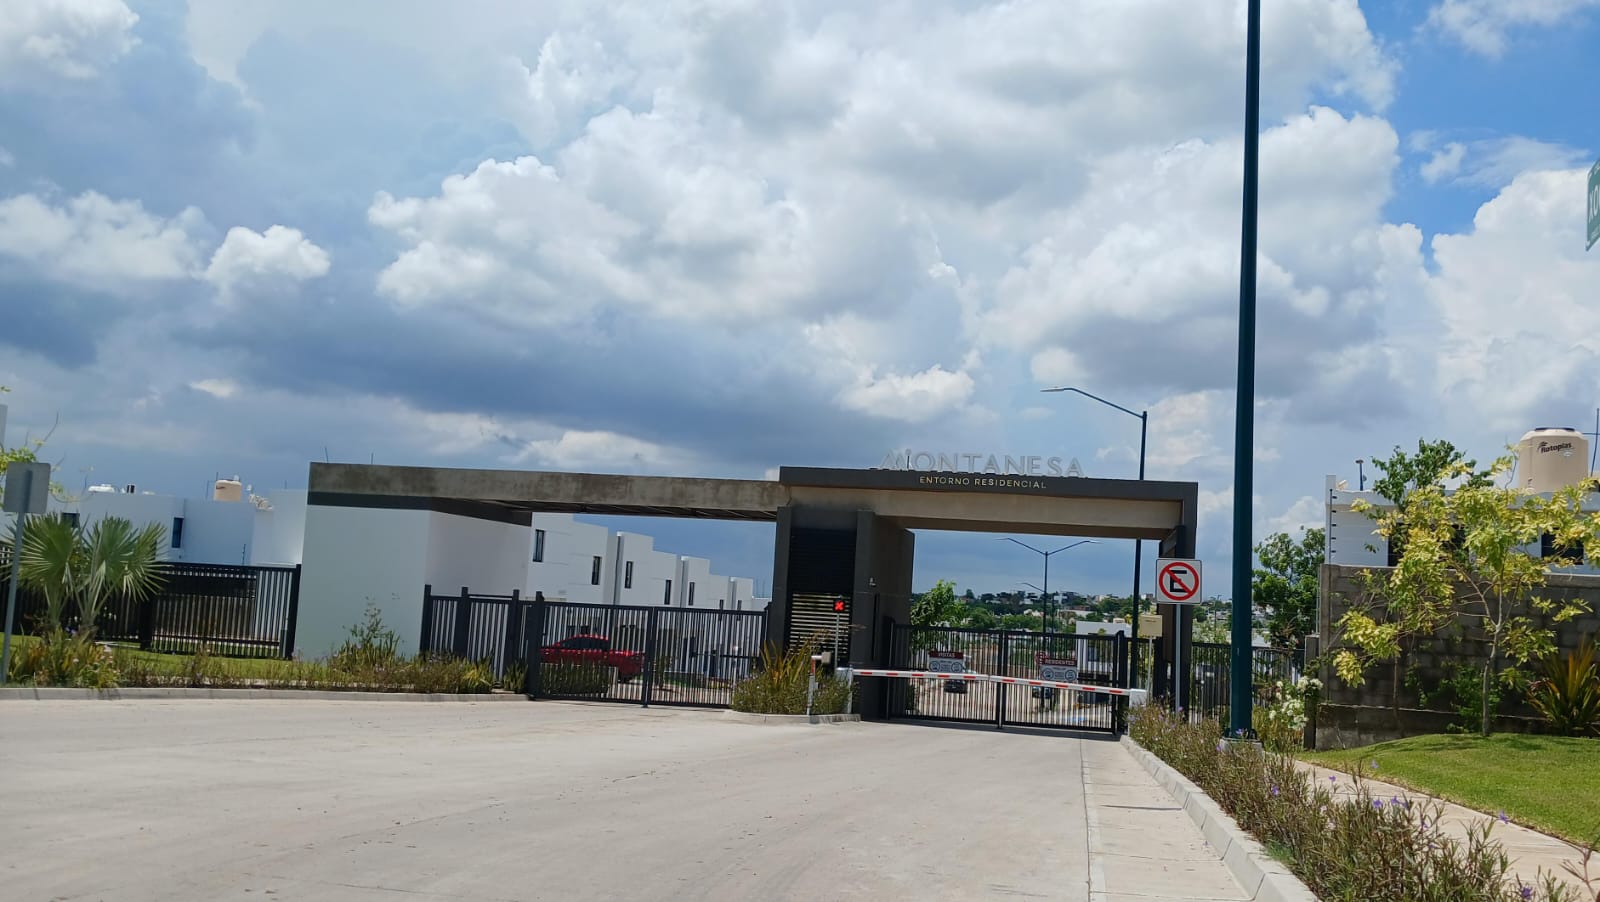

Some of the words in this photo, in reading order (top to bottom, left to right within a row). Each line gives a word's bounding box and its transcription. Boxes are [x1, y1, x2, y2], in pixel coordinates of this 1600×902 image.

[880, 449, 1084, 477] MONTANESA
[919, 475, 970, 486] ENTORNO
[974, 478, 1047, 490] RESIDENCIAL
